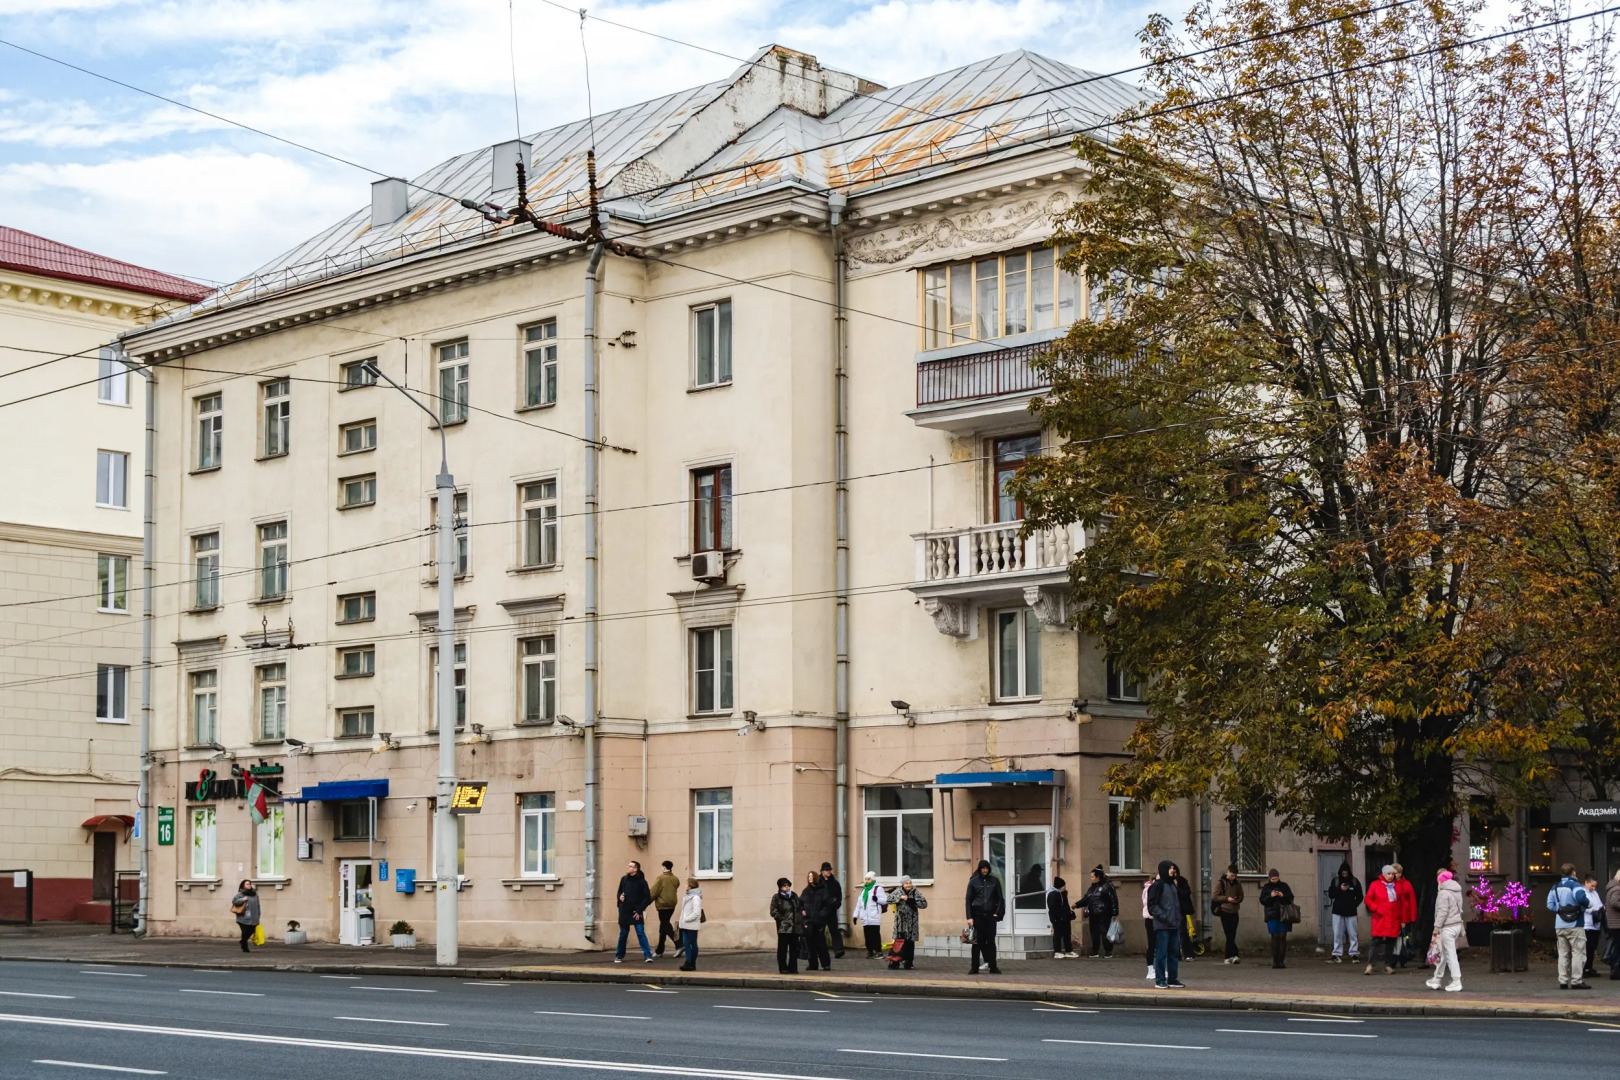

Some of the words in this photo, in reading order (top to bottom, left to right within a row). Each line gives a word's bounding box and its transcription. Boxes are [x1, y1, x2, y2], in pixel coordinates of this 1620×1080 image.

[1578, 806, 1617, 817] Акадэмія
[160, 824, 171, 842] 16
[1469, 845, 1486, 860] АФЕ
